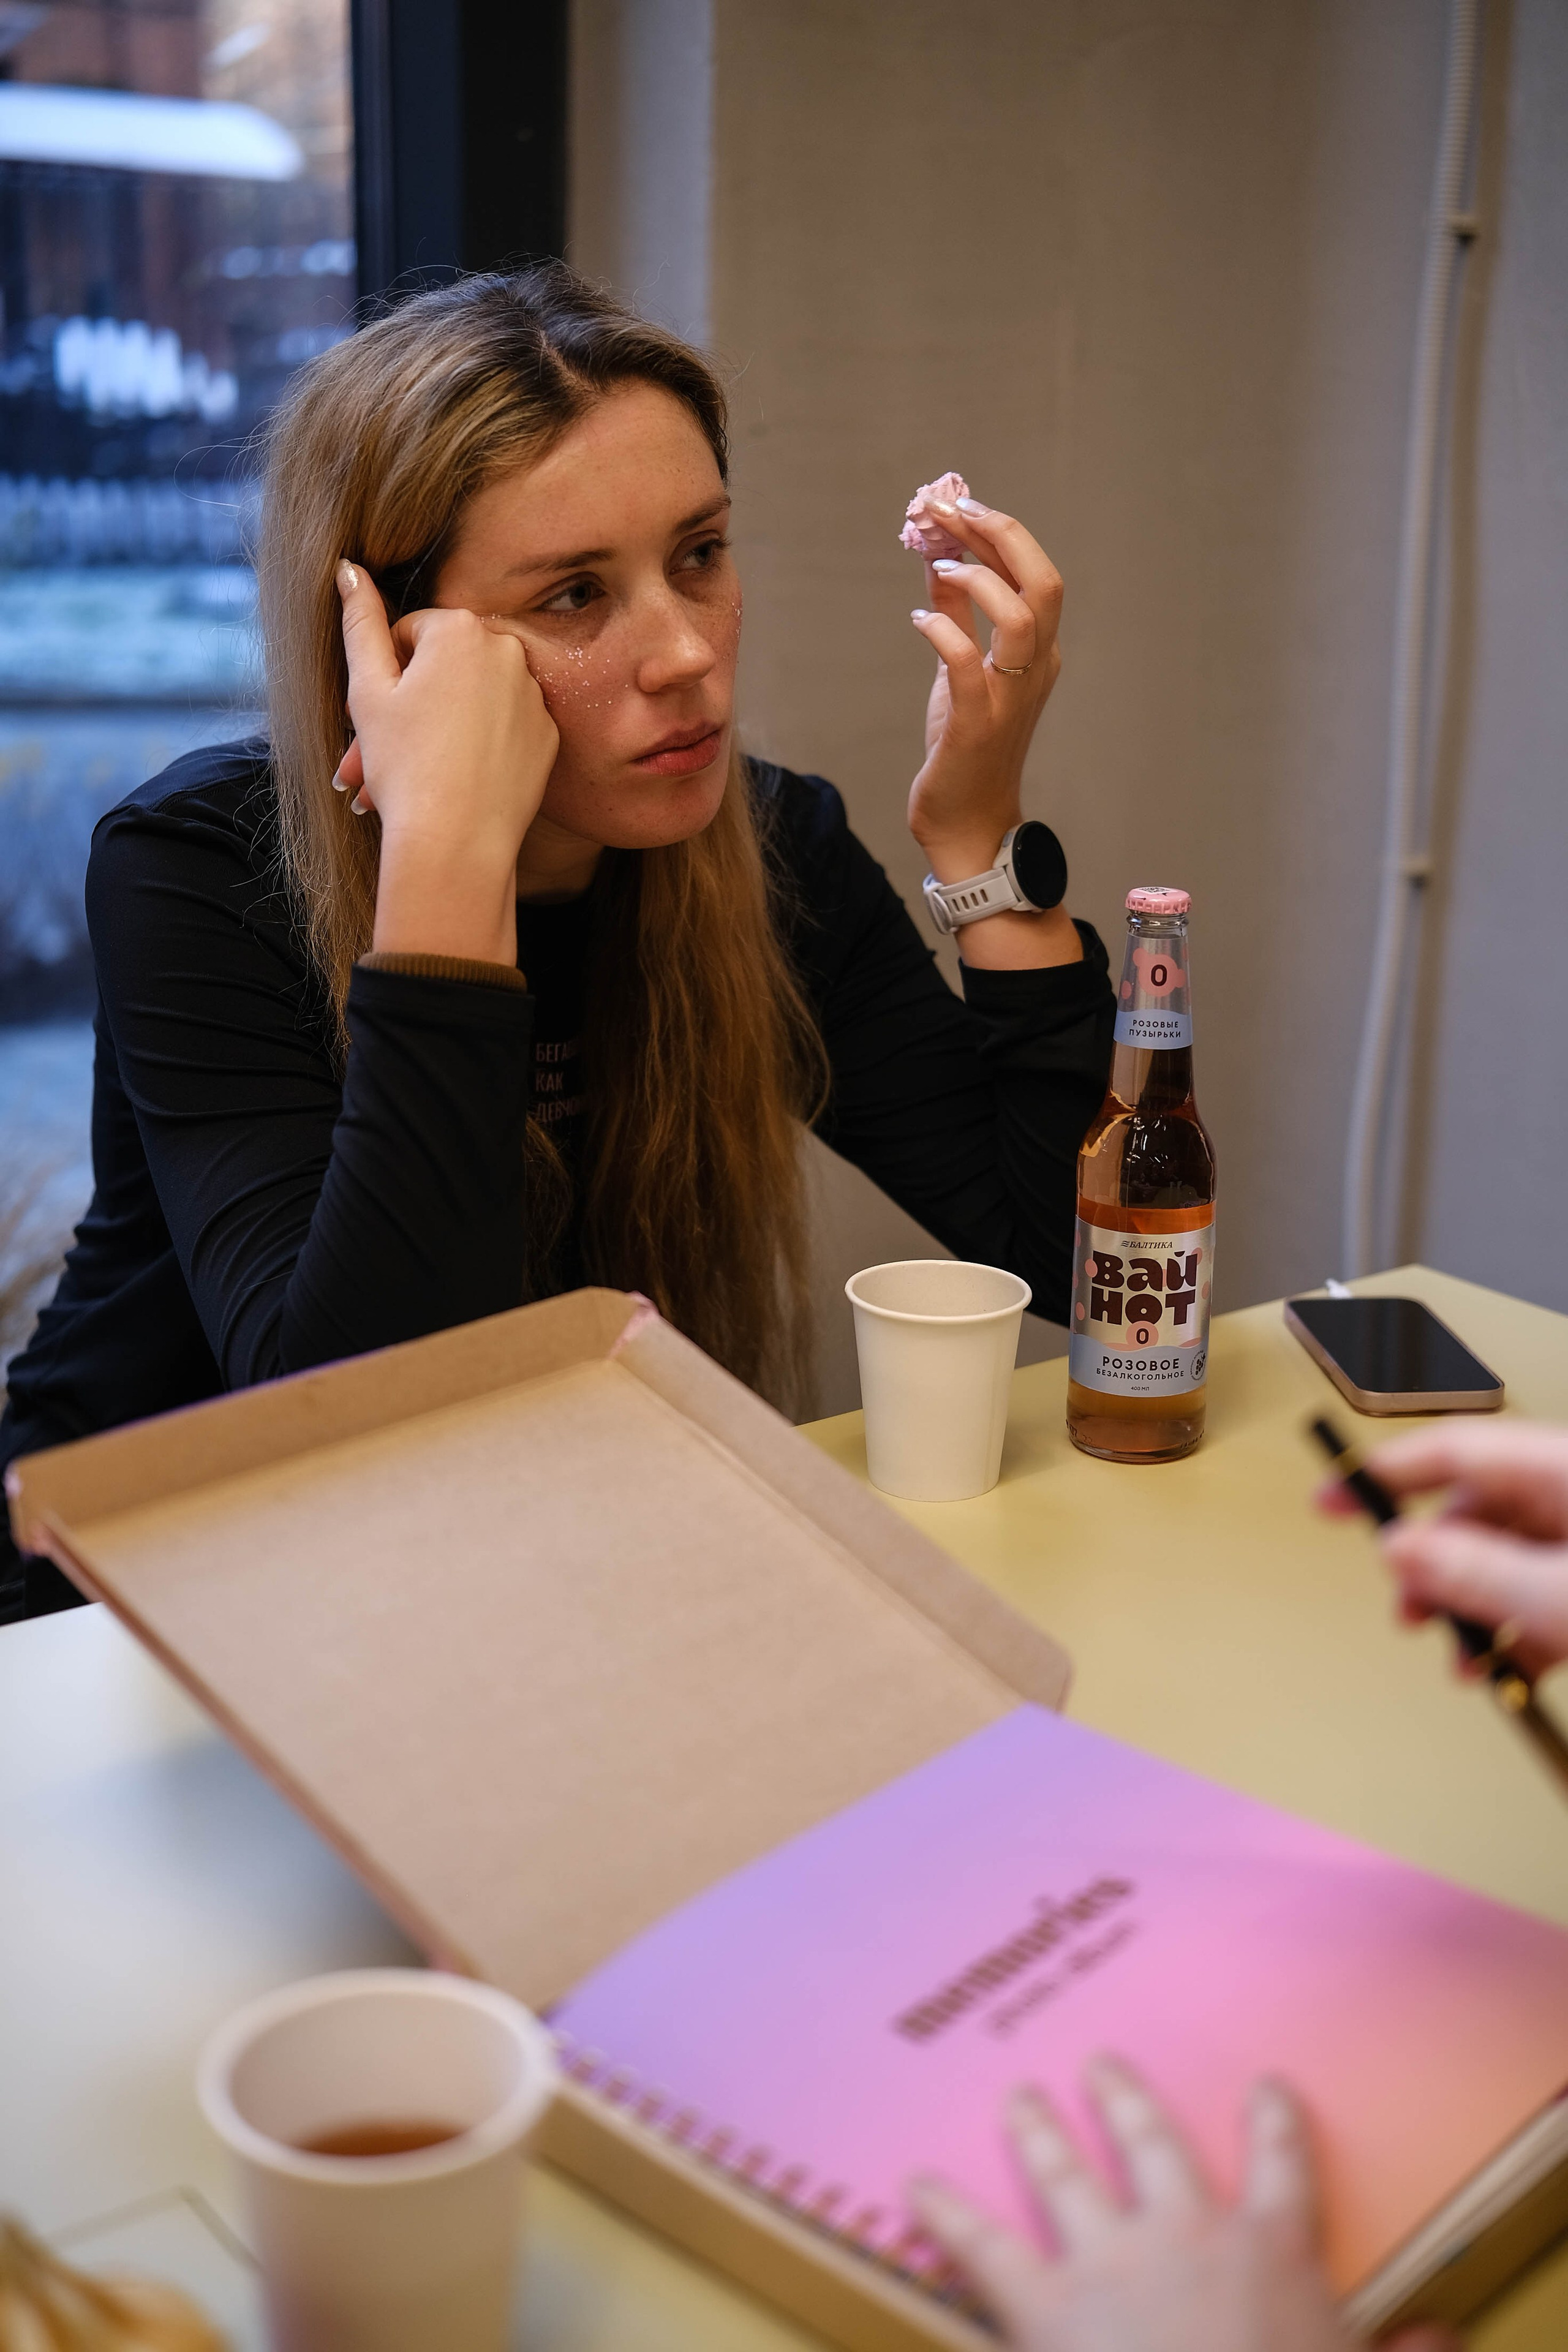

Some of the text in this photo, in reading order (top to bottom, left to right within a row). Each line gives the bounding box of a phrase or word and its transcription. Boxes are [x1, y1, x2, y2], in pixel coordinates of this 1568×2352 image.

[1151, 964, 1167, 986] 0
[1132, 1019, 1179, 1028] РОЗОВЫЕ
[1129, 1029, 1181, 1038] ПУЗЫРЬКИ
[535, 1070, 564, 1092] КАК
[536, 1098, 580, 1123] ДЕВЧО
[1136, 1328, 1149, 1344] 0
[1102, 1356, 1179, 1371] РОЗОВОЕ
[1096, 1368, 1185, 1380] БЕЗАЛКОГОЛЬНОЕ
